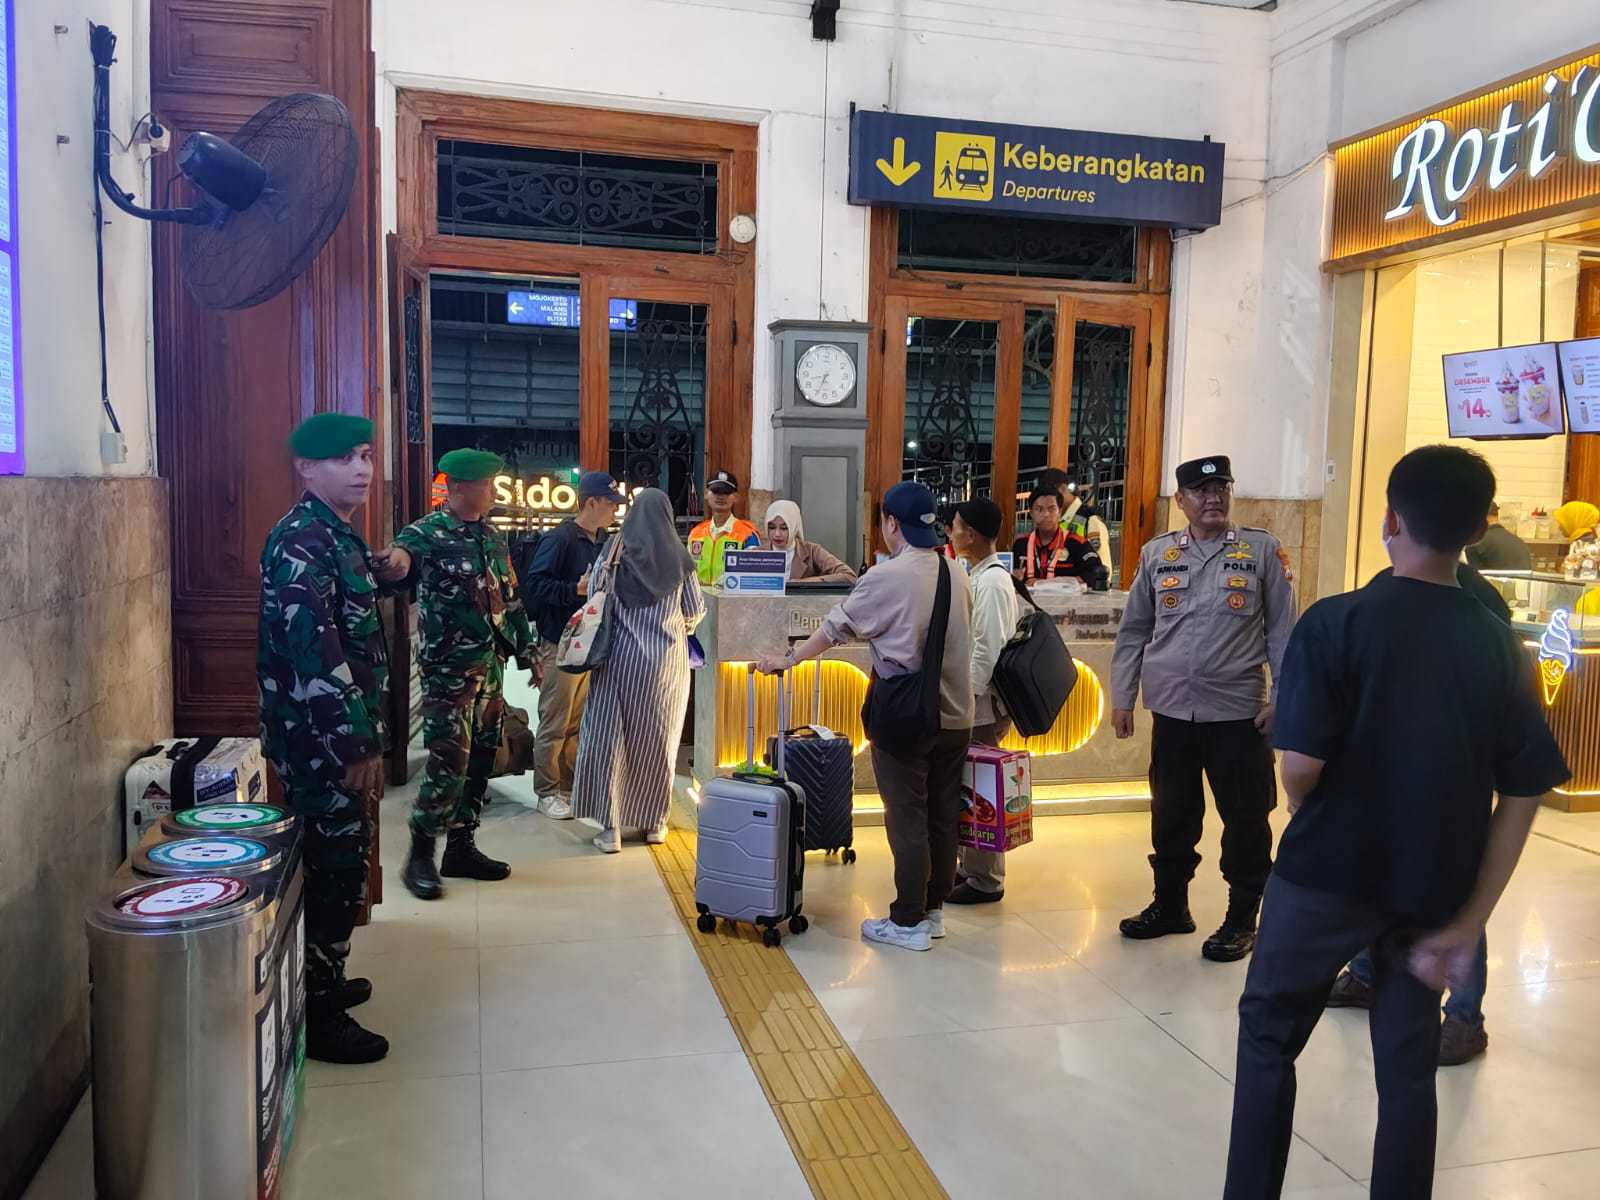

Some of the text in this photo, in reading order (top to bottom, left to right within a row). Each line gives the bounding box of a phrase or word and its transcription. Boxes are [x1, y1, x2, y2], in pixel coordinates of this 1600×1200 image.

[1003, 142, 1206, 185] Keberangkatan
[1002, 180, 1096, 203] Departures
[1223, 563, 1256, 571] POLRI
